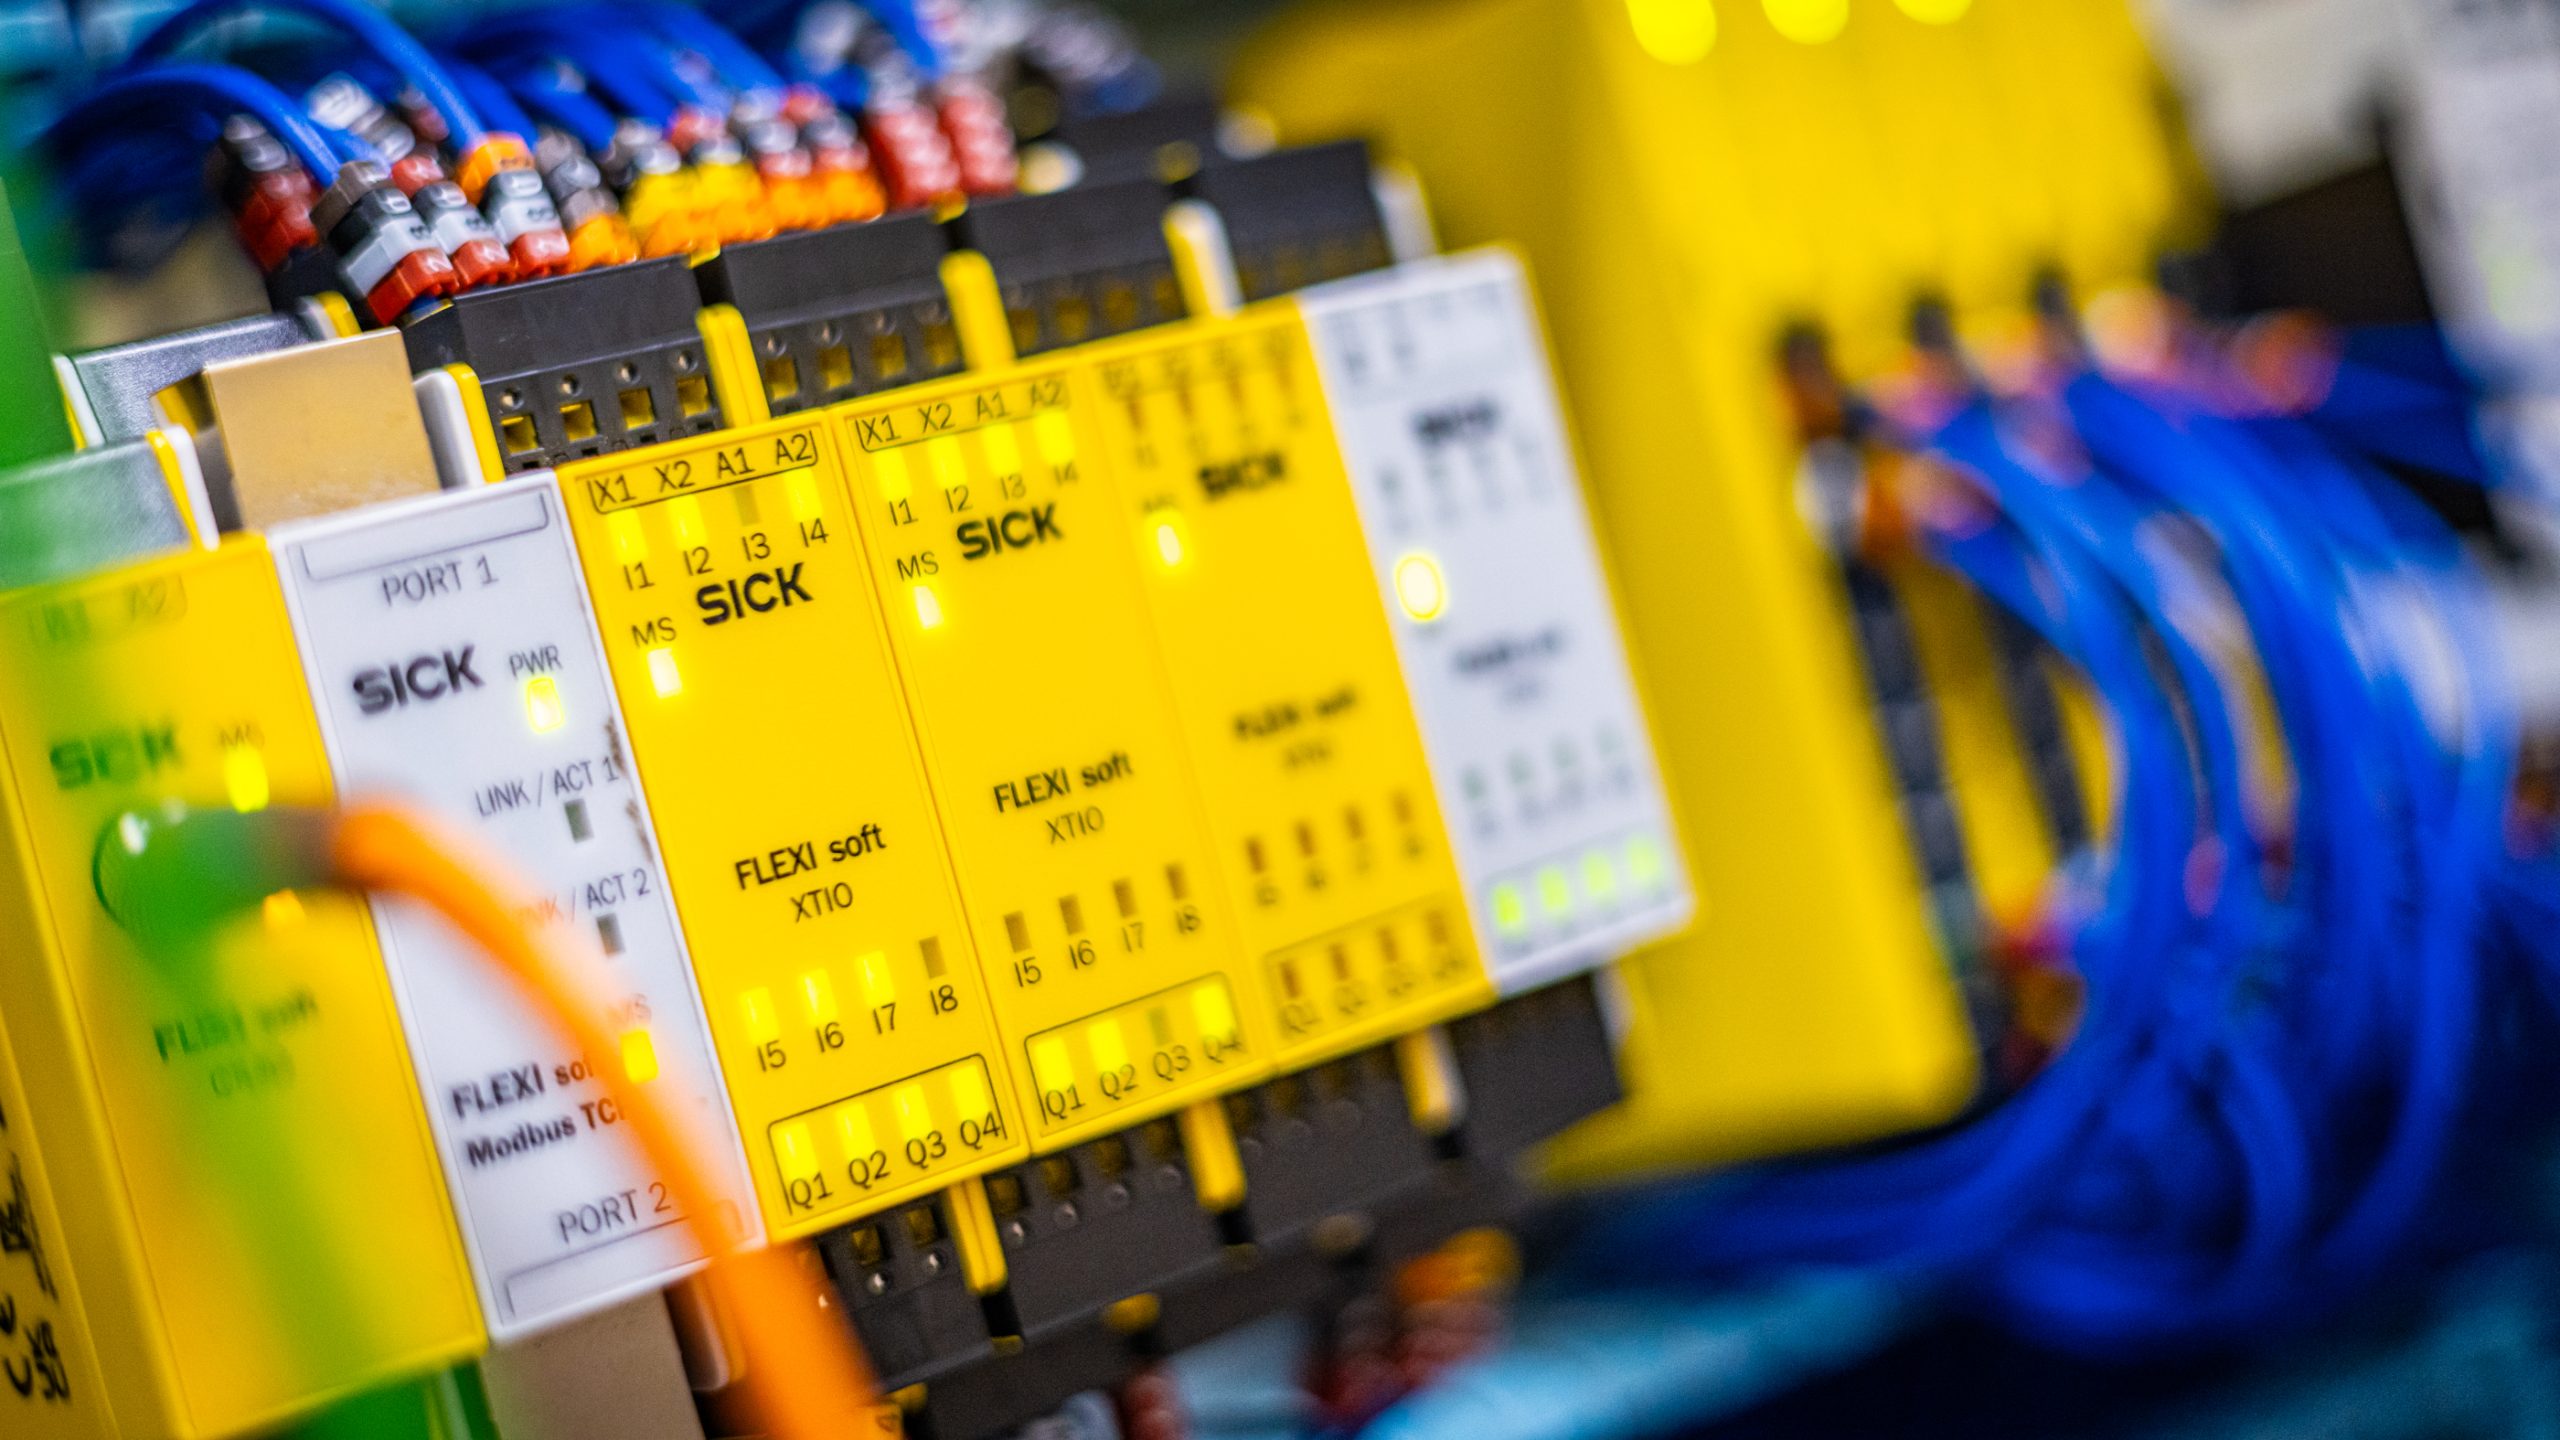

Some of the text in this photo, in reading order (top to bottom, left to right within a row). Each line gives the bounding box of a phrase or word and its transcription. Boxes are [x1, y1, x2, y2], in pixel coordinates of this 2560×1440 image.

[861, 380, 1062, 445] X1 X2 A1 A2
[595, 433, 812, 507] X1 X2 A1 A2
[888, 498, 918, 526] I1
[945, 485, 973, 513] I2
[956, 501, 1063, 560] SICK
[382, 554, 499, 607] PORT 1
[624, 518, 828, 591] I1 I2 I3 I4
[897, 551, 939, 582] MS
[696, 562, 814, 626] SICK
[509, 645, 563, 679] PWR
[631, 617, 677, 648] MS
[353, 644, 486, 715] SICK
[476, 780, 531, 817] LINK
[553, 761, 594, 796] ACT
[602, 756, 619, 781] 1
[993, 752, 1133, 813] FLEXI soft
[1046, 806, 1105, 845] XTIO
[734, 823, 887, 890] FLEXI soft
[587, 874, 626, 909] ACT
[633, 868, 651, 896] 2
[790, 882, 854, 923] XTIO
[1014, 957, 1042, 987] I5
[1068, 939, 1096, 970] I6
[1121, 922, 1145, 953] I7
[757, 984, 958, 1072] I5 I6 I7 I8
[452, 1063, 545, 1118] FLEXI
[1045, 1083, 1085, 1120] Q1
[1100, 1063, 1139, 1100] Q2
[1152, 1045, 1191, 1081] Q3
[466, 1114, 577, 1168] Modbus
[789, 1111, 1000, 1210] Q1 Q2 Q3 Q4
[558, 1181, 671, 1244] PORT 2
